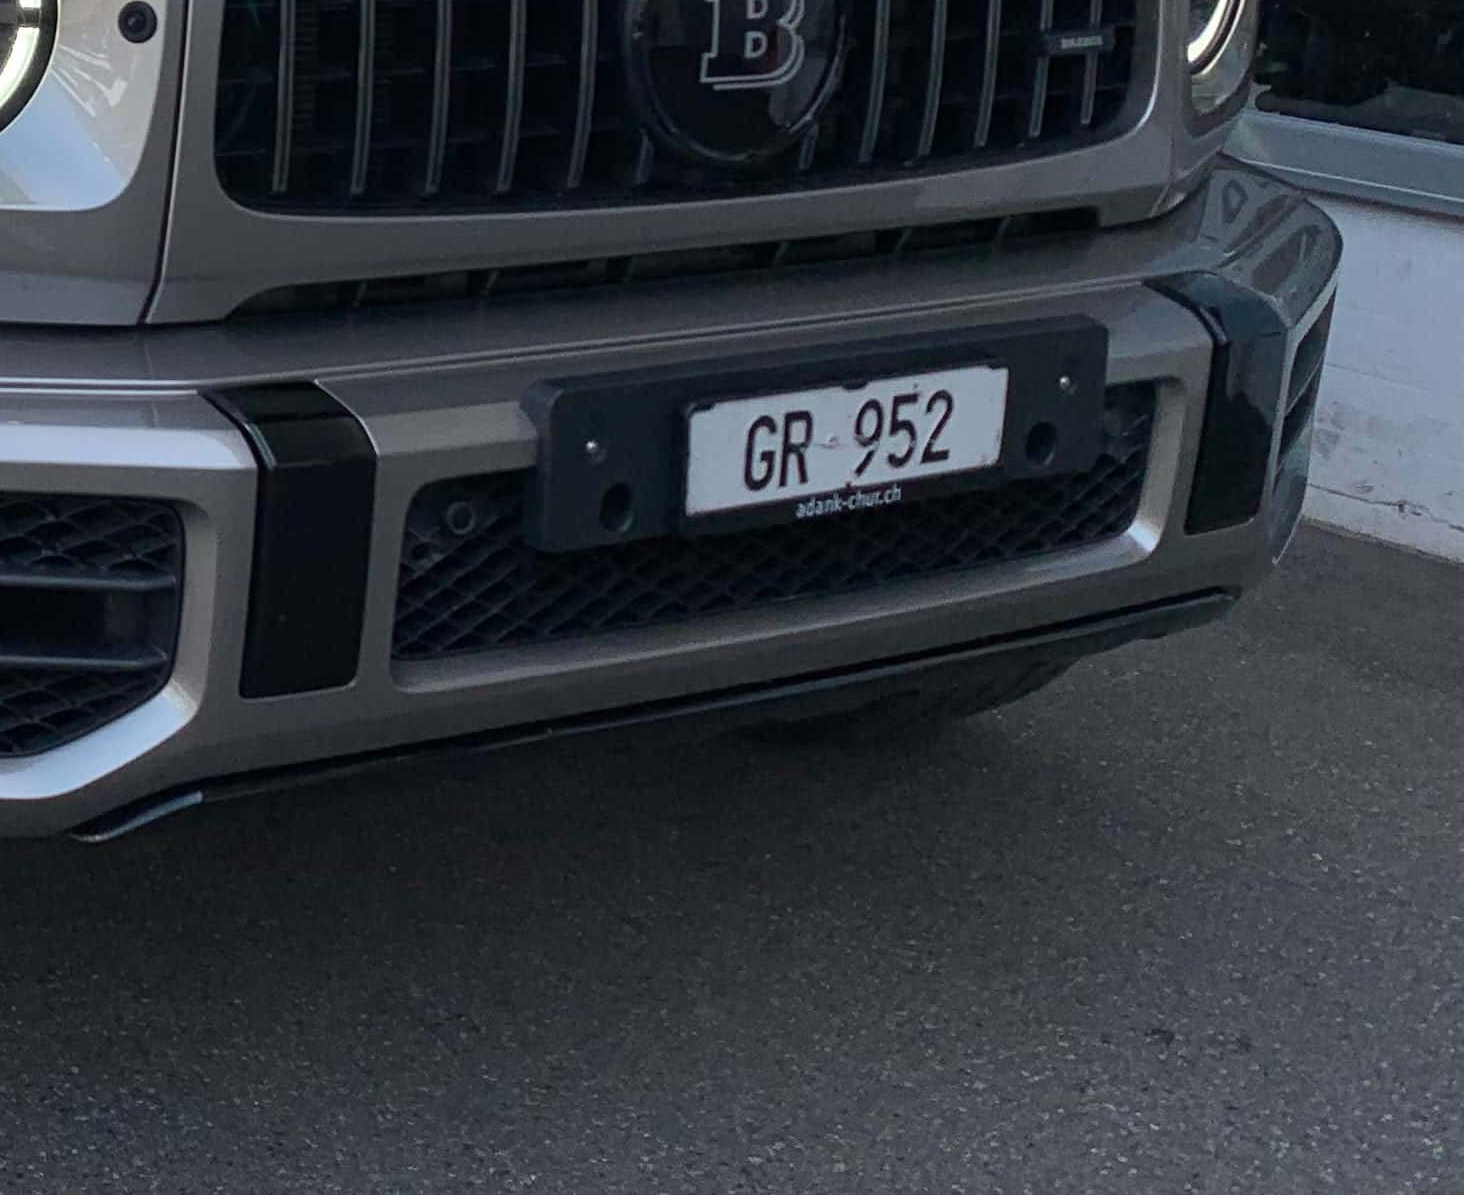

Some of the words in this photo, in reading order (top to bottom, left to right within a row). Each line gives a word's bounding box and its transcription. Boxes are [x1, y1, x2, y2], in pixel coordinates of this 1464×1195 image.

[744, 409, 814, 492] GR
[854, 389, 954, 477] 952
[796, 483, 902, 518] adank-chur.ch
